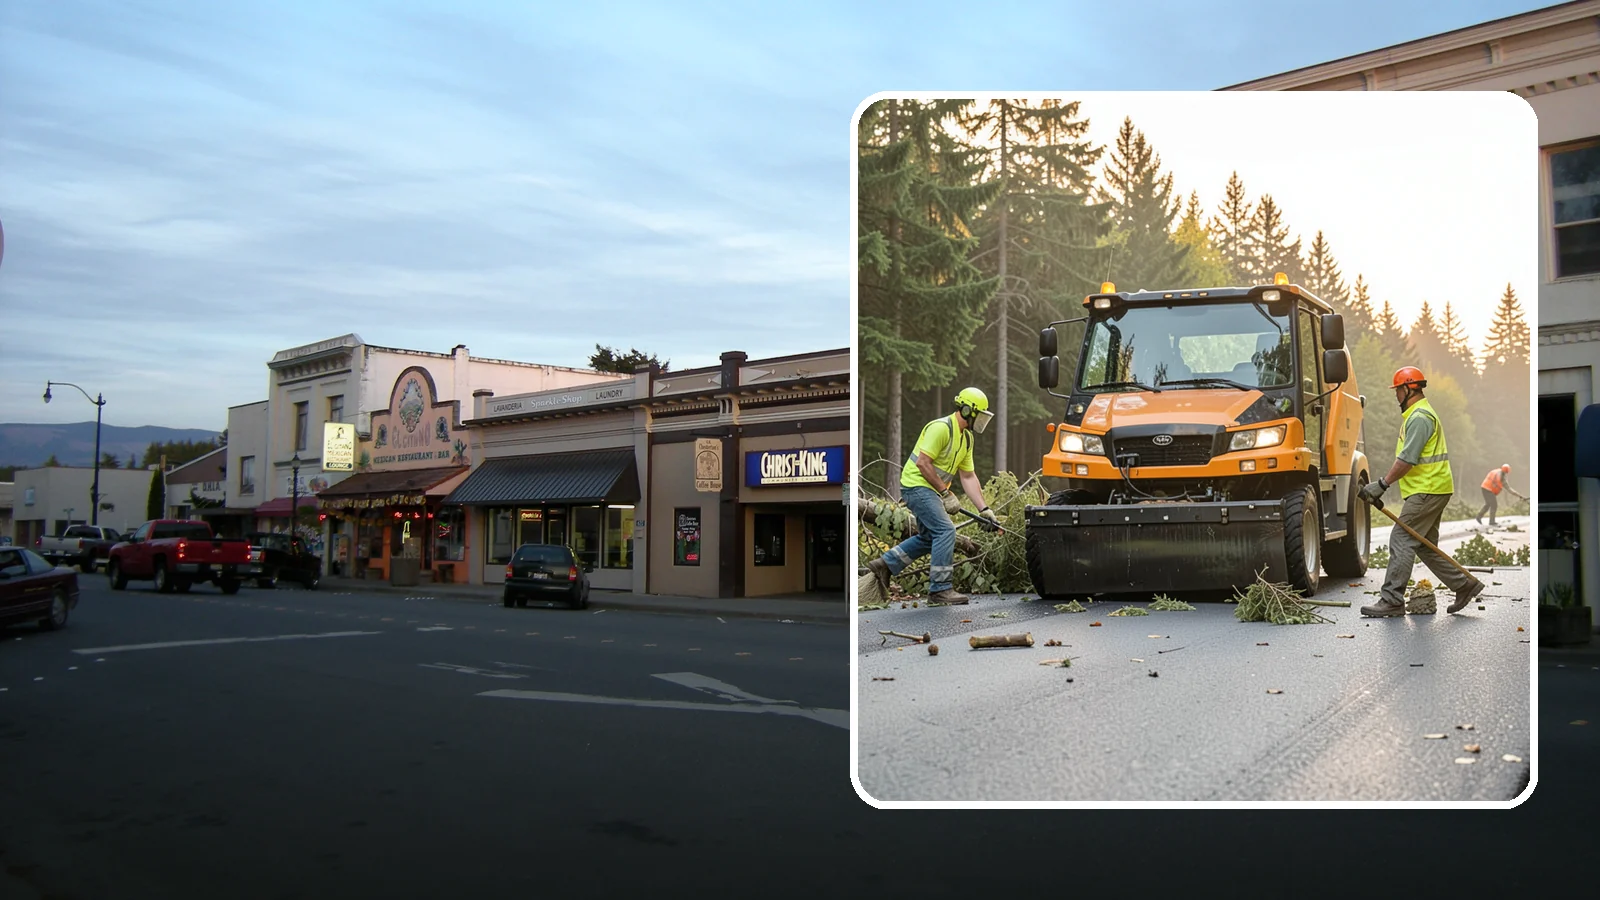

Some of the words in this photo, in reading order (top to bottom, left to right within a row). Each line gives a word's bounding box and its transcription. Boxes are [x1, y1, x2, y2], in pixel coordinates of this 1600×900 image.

[562, 394, 582, 404] Shop
[596, 389, 624, 400] LAUNDRY
[494, 402, 522, 412] LAVANDERIA
[374, 454, 396, 464] MEXICAN
[398, 452, 433, 462] RESTAURANT
[438, 450, 450, 459] BAR
[799, 450, 827, 476] KING
